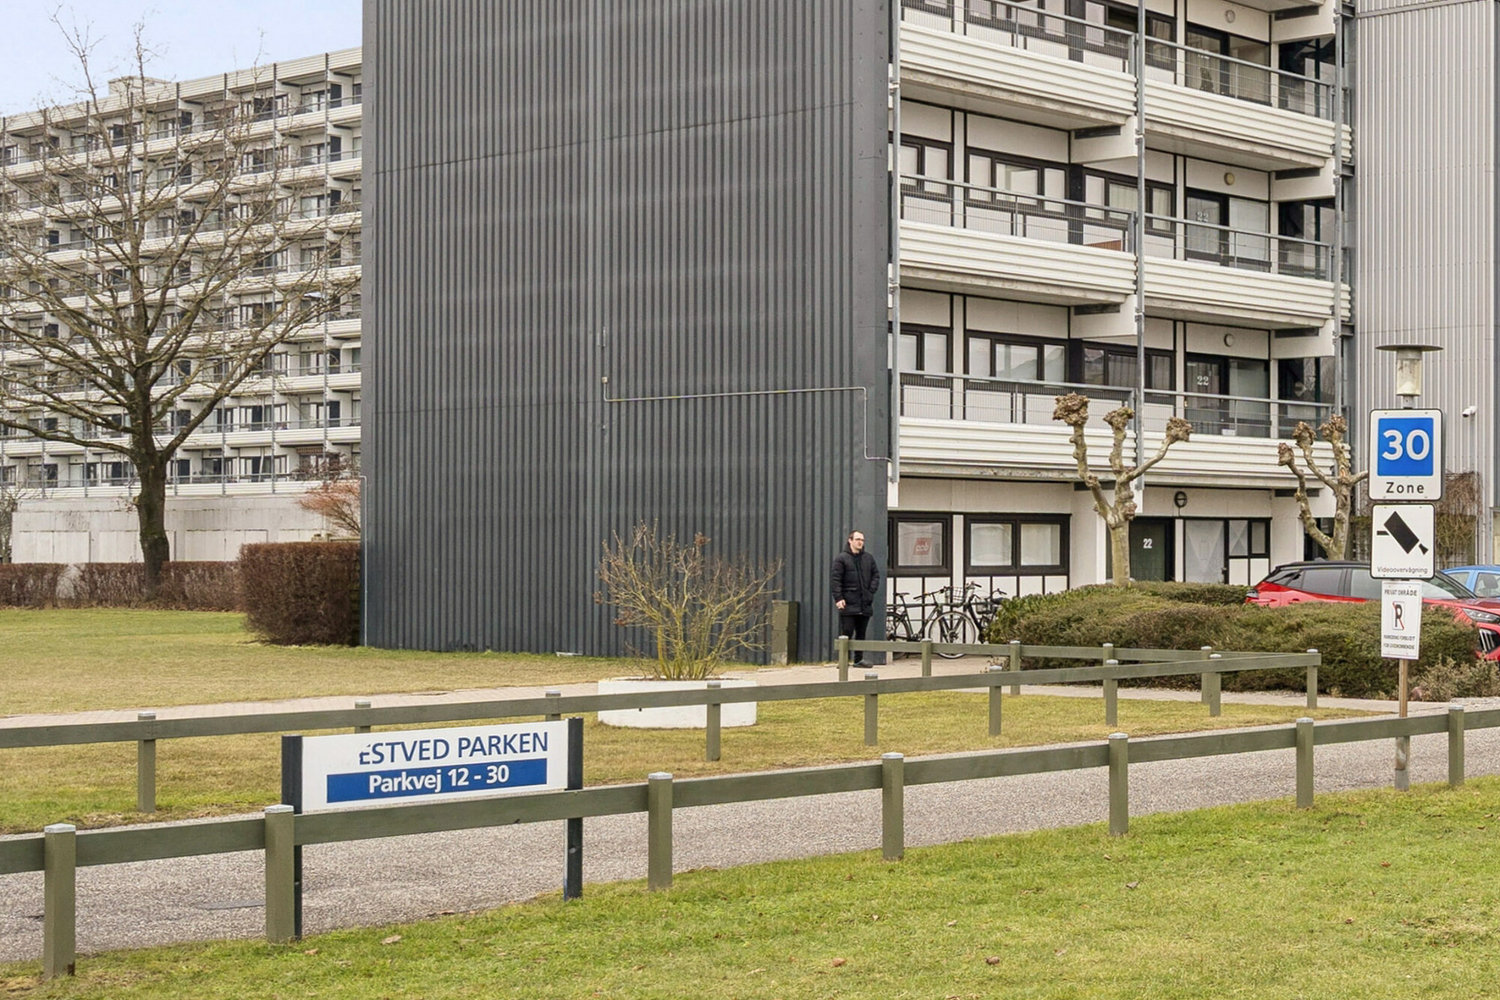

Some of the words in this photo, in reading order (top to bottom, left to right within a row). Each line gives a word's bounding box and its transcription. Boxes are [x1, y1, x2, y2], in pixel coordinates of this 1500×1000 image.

[1197, 375, 1209, 386] 22
[1382, 429, 1430, 460] 30
[1386, 481, 1425, 494] Zone
[1143, 538, 1153, 549] 22
[1377, 566, 1428, 575] Videoovervågning
[1398, 589, 1418, 597] OMRÅDE
[458, 732, 548, 758] PARKEN
[369, 769, 442, 793] Parkvej
[448, 767, 469, 787] 12
[486, 764, 510, 784] 30
